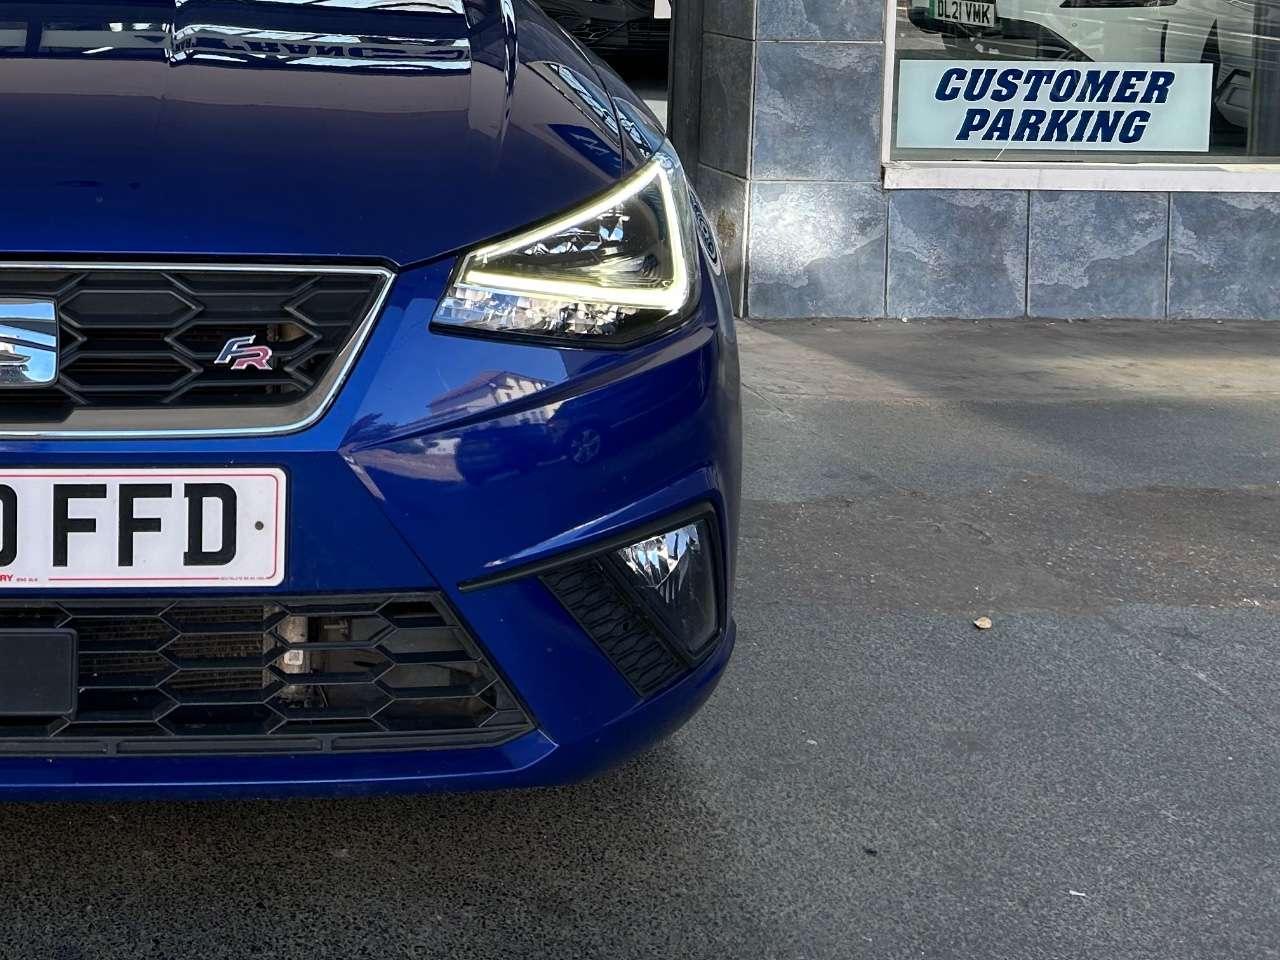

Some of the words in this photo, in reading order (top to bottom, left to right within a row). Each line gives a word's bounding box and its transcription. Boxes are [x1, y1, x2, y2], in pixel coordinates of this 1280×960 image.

[965, 2, 990, 24] VMK
[934, 68, 1175, 103] CUSTOMER
[955, 108, 1151, 144] PARKING
[214, 334, 272, 370] FR
[52, 482, 237, 567] FFD
